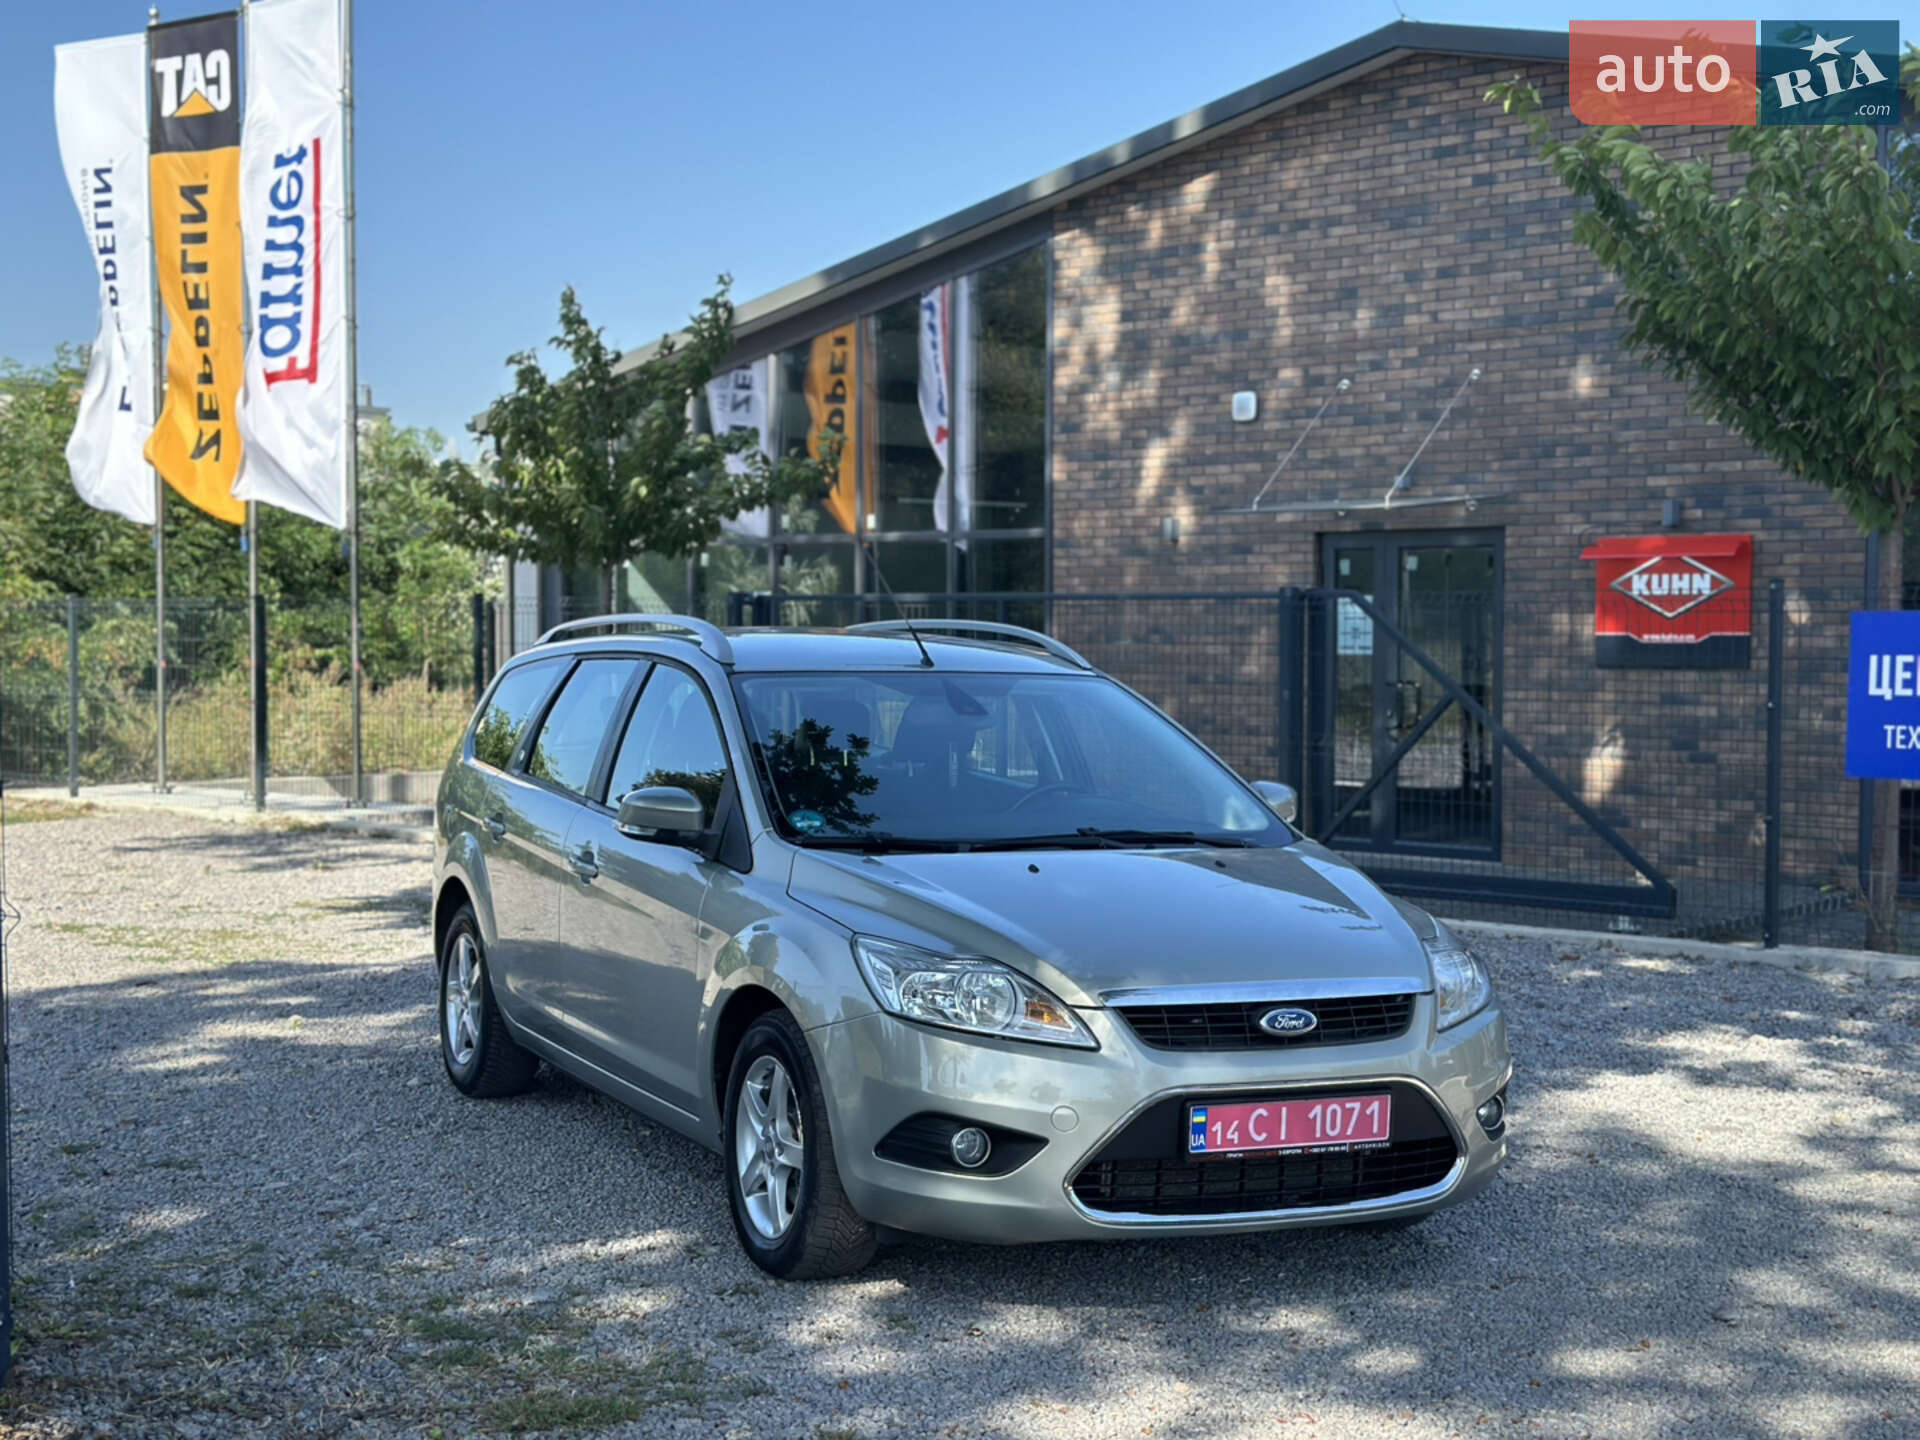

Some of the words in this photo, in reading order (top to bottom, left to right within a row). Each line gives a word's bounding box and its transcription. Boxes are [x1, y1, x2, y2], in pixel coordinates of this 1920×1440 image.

[1631, 573, 1712, 596] KUHN
[1868, 654, 1920, 700] ЦЕ
[1274, 1014, 1305, 1029] Ford
[1211, 1121, 1240, 1146] 14
[1307, 1100, 1380, 1138] 1071
[1191, 1133, 1206, 1147] UA
